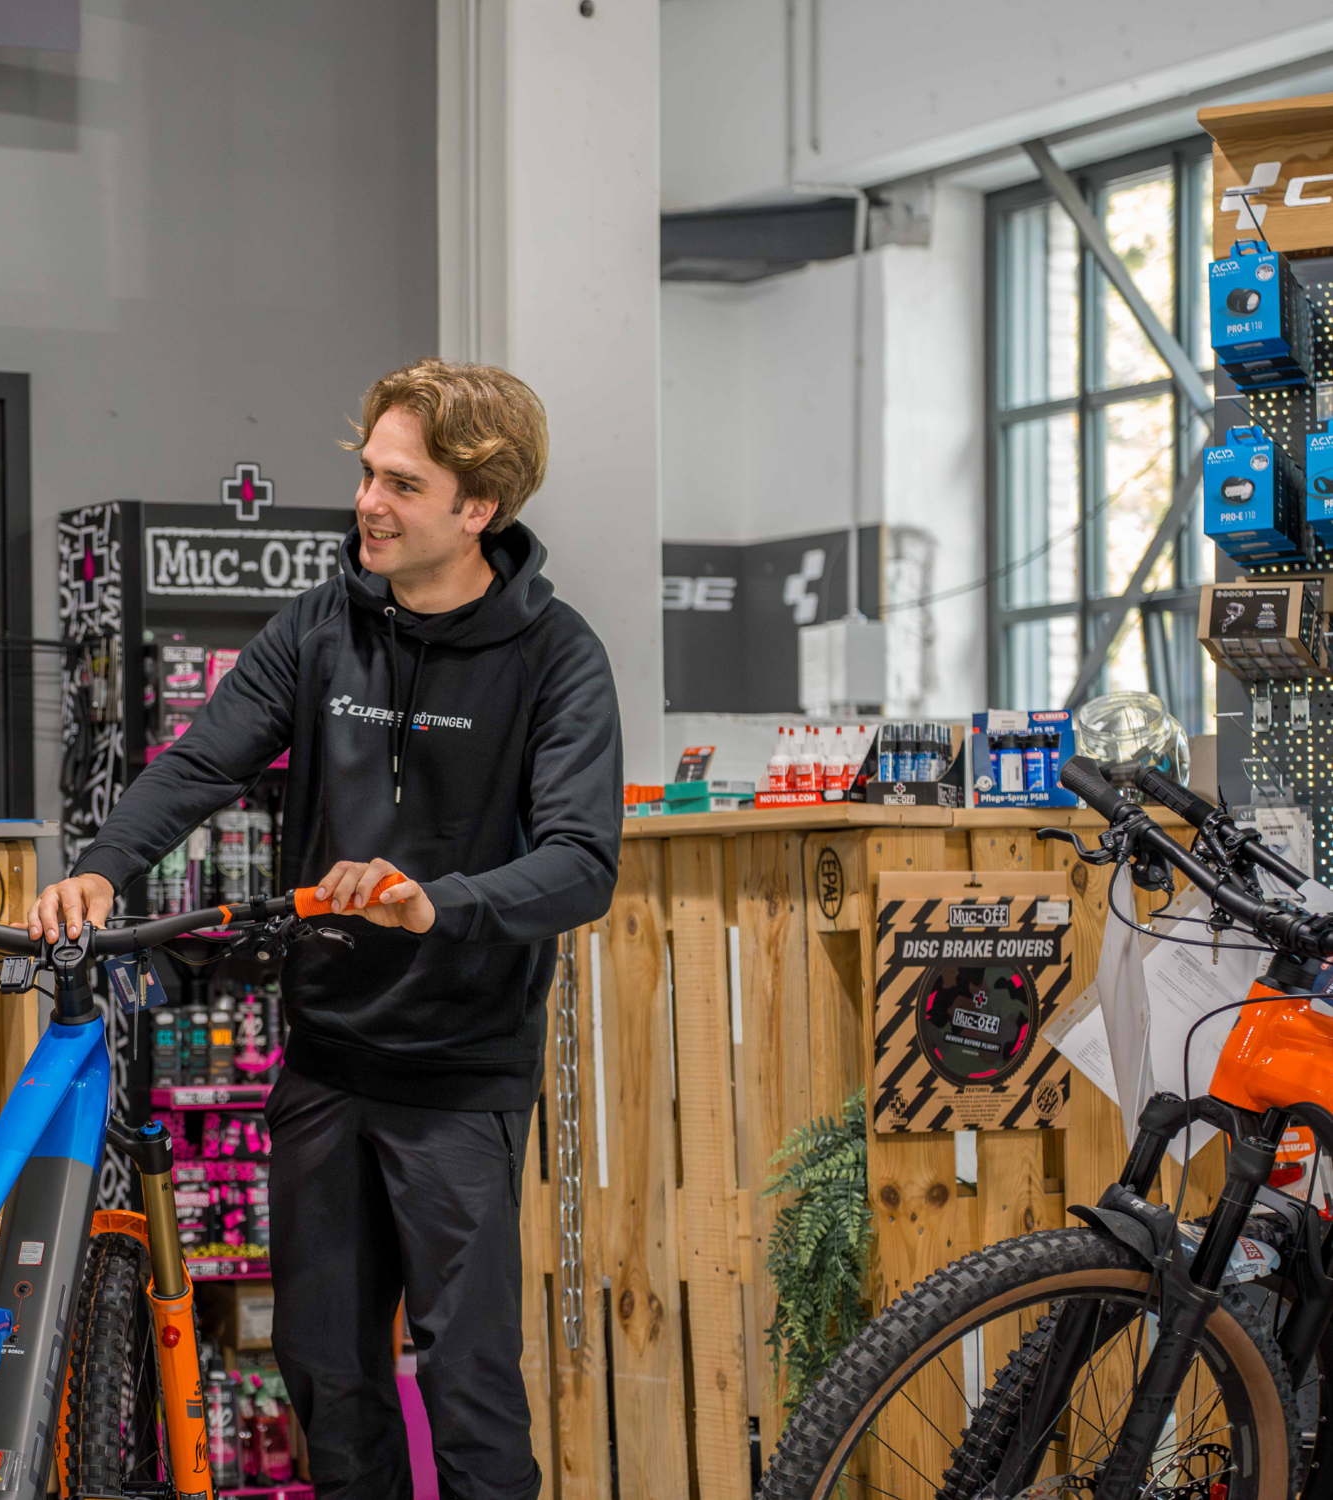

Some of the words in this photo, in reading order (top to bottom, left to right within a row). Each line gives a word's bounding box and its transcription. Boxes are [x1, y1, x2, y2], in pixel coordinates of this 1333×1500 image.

[1227, 322, 1250, 334] PRO-E
[1221, 512, 1243, 522] PRO-E
[1244, 511, 1256, 519] 110
[156, 539, 338, 588] Muc-Off
[662, 576, 737, 611] BE
[347, 704, 404, 721] CUBE
[413, 712, 472, 729] GÖTTINGEN
[760, 793, 816, 803] NOTUBES.COM
[981, 793, 1028, 803] Pflege-Spray
[821, 858, 839, 910] EPAL
[952, 907, 1007, 925] Muc-Off
[902, 940, 939, 958] DISC
[942, 940, 993, 958] BRAKE
[996, 939, 1054, 958] COVERS
[956, 1011, 998, 1031] Muc-Off
